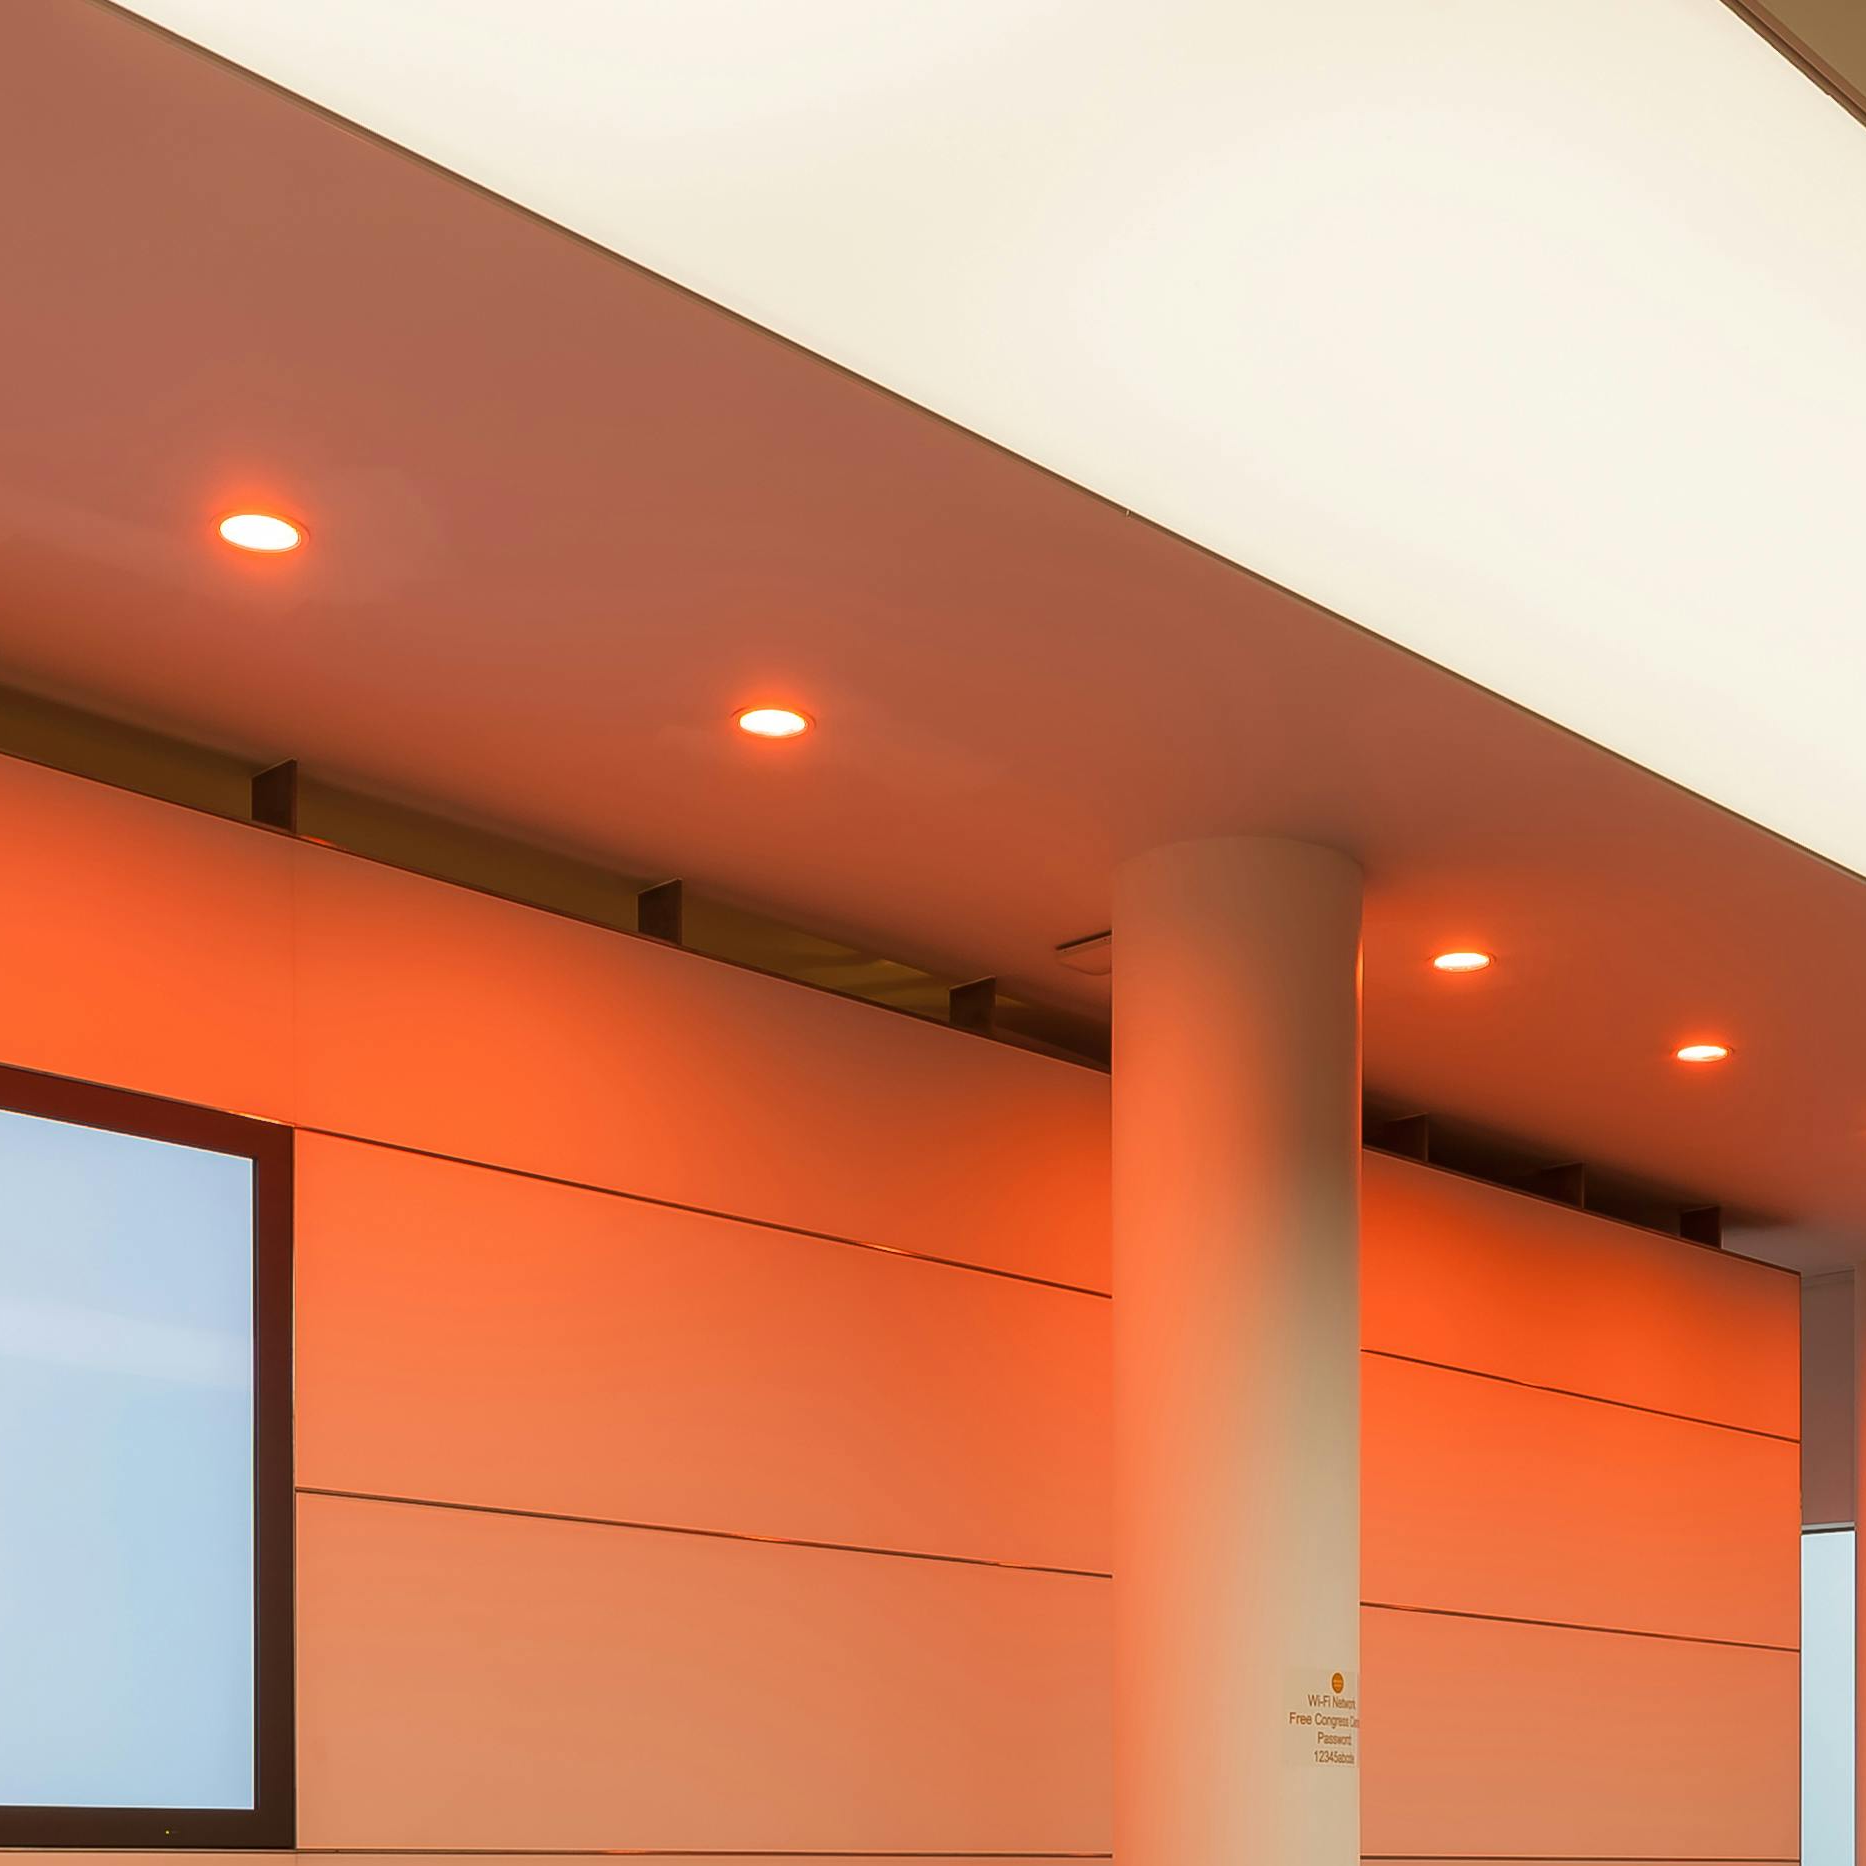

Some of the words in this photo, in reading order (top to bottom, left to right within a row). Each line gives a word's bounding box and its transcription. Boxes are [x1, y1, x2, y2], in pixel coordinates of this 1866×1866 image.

[1307, 1694, 1331, 1708] Wi-Fi
[1289, 1711, 1313, 1725] Free
[1315, 1713, 1349, 1729] Congress
[1317, 1732, 1352, 1745] Password
